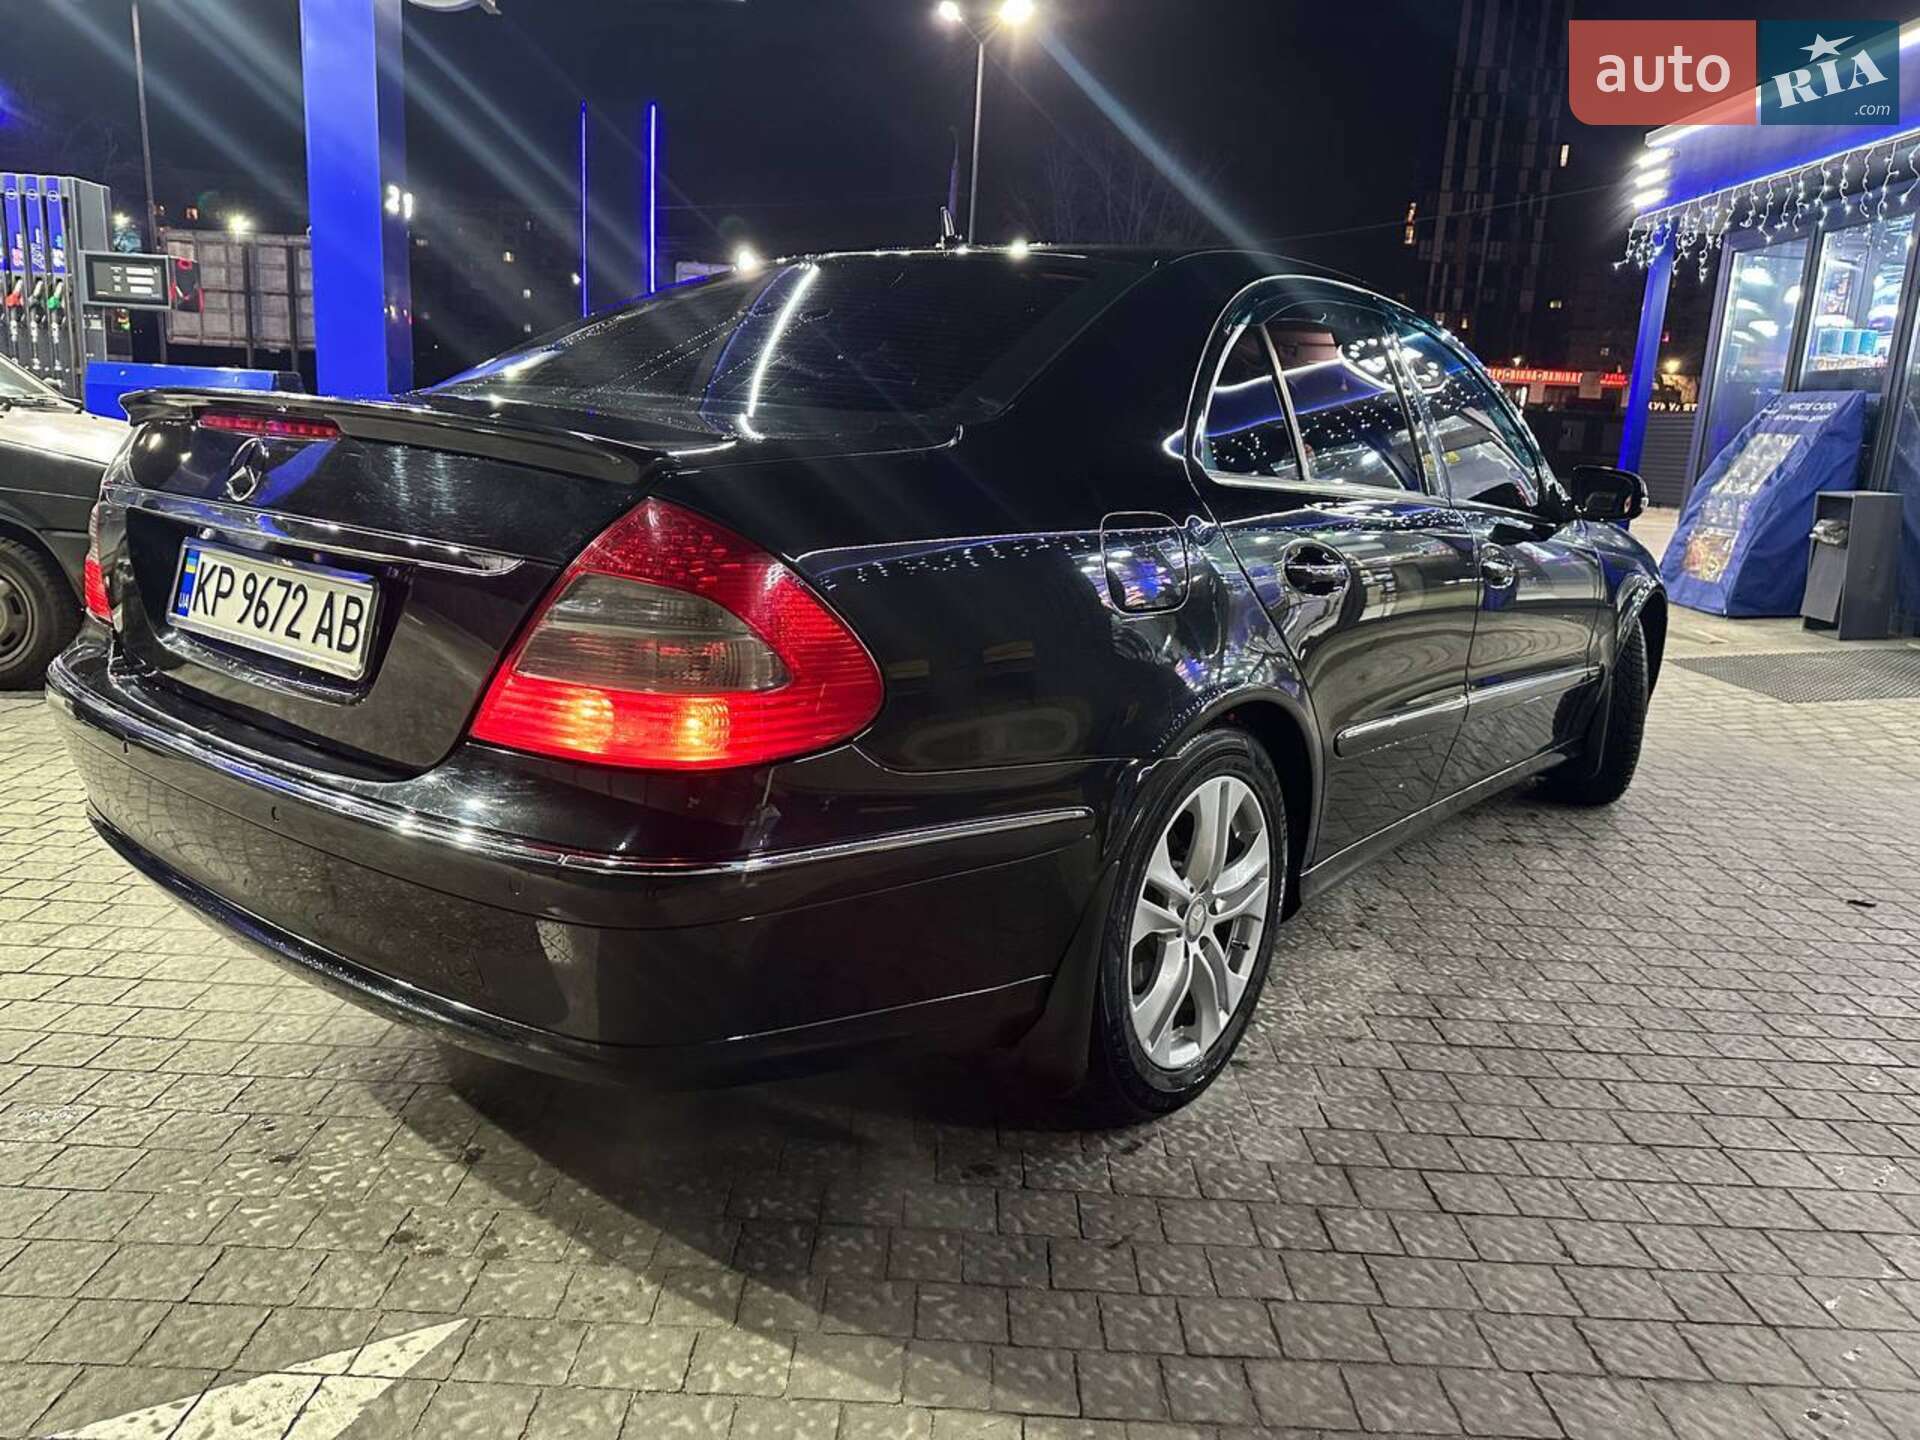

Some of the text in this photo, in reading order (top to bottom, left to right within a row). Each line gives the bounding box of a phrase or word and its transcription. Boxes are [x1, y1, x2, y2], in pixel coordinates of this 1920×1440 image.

[192, 562, 364, 653] KP 9672 AB
